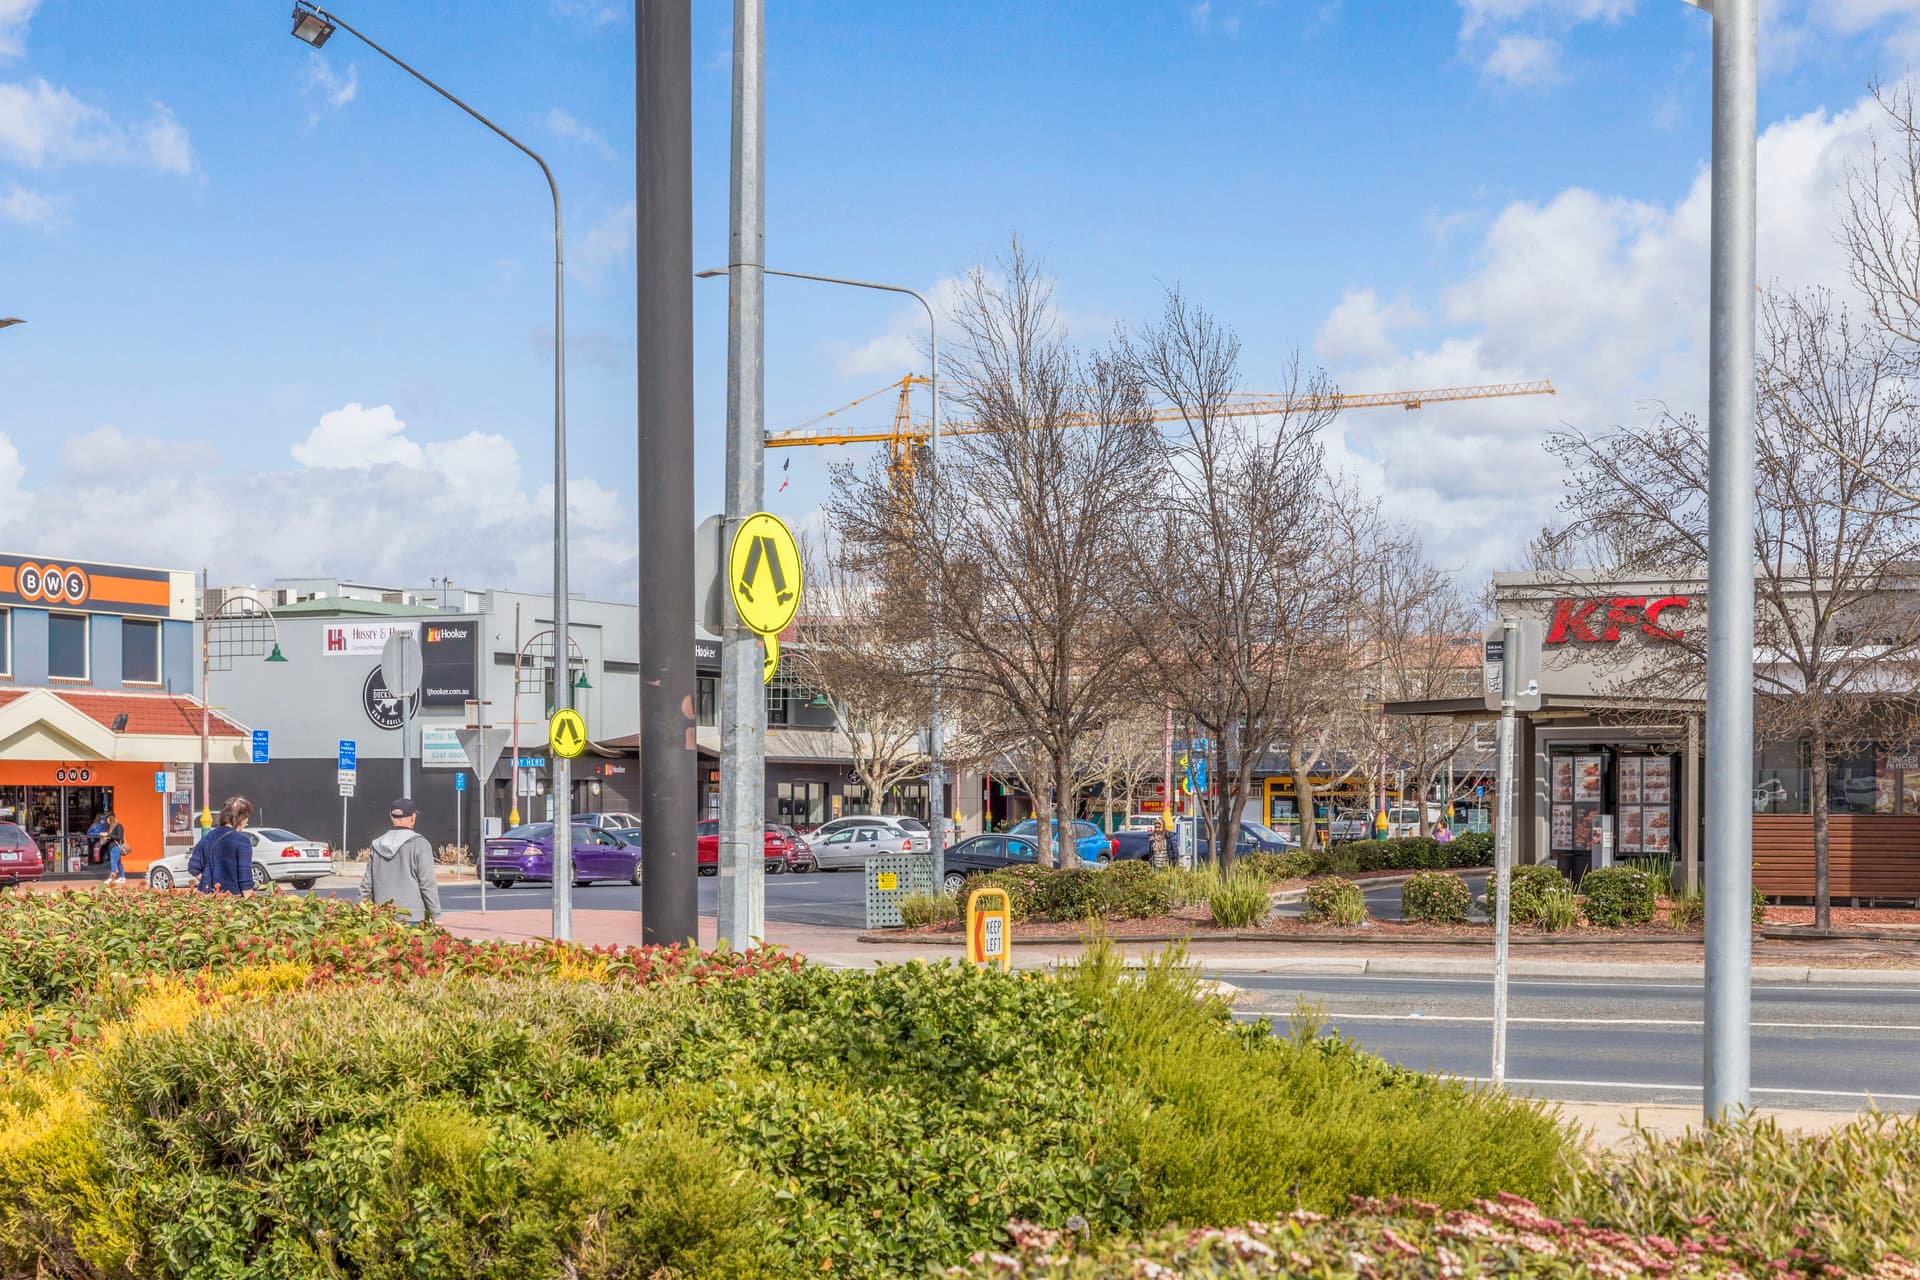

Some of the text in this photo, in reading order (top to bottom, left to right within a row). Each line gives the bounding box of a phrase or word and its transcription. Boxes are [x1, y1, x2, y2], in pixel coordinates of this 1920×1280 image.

[26, 573, 79, 593] BWS
[1545, 596, 1689, 643] KFC
[380, 627, 386, 640] &
[441, 628, 467, 638] Hooker
[695, 645, 715, 658] Hooker
[58, 771, 88, 779] BWS
[986, 920, 1001, 934] KEEP
[986, 937, 1001, 952] LEFT
